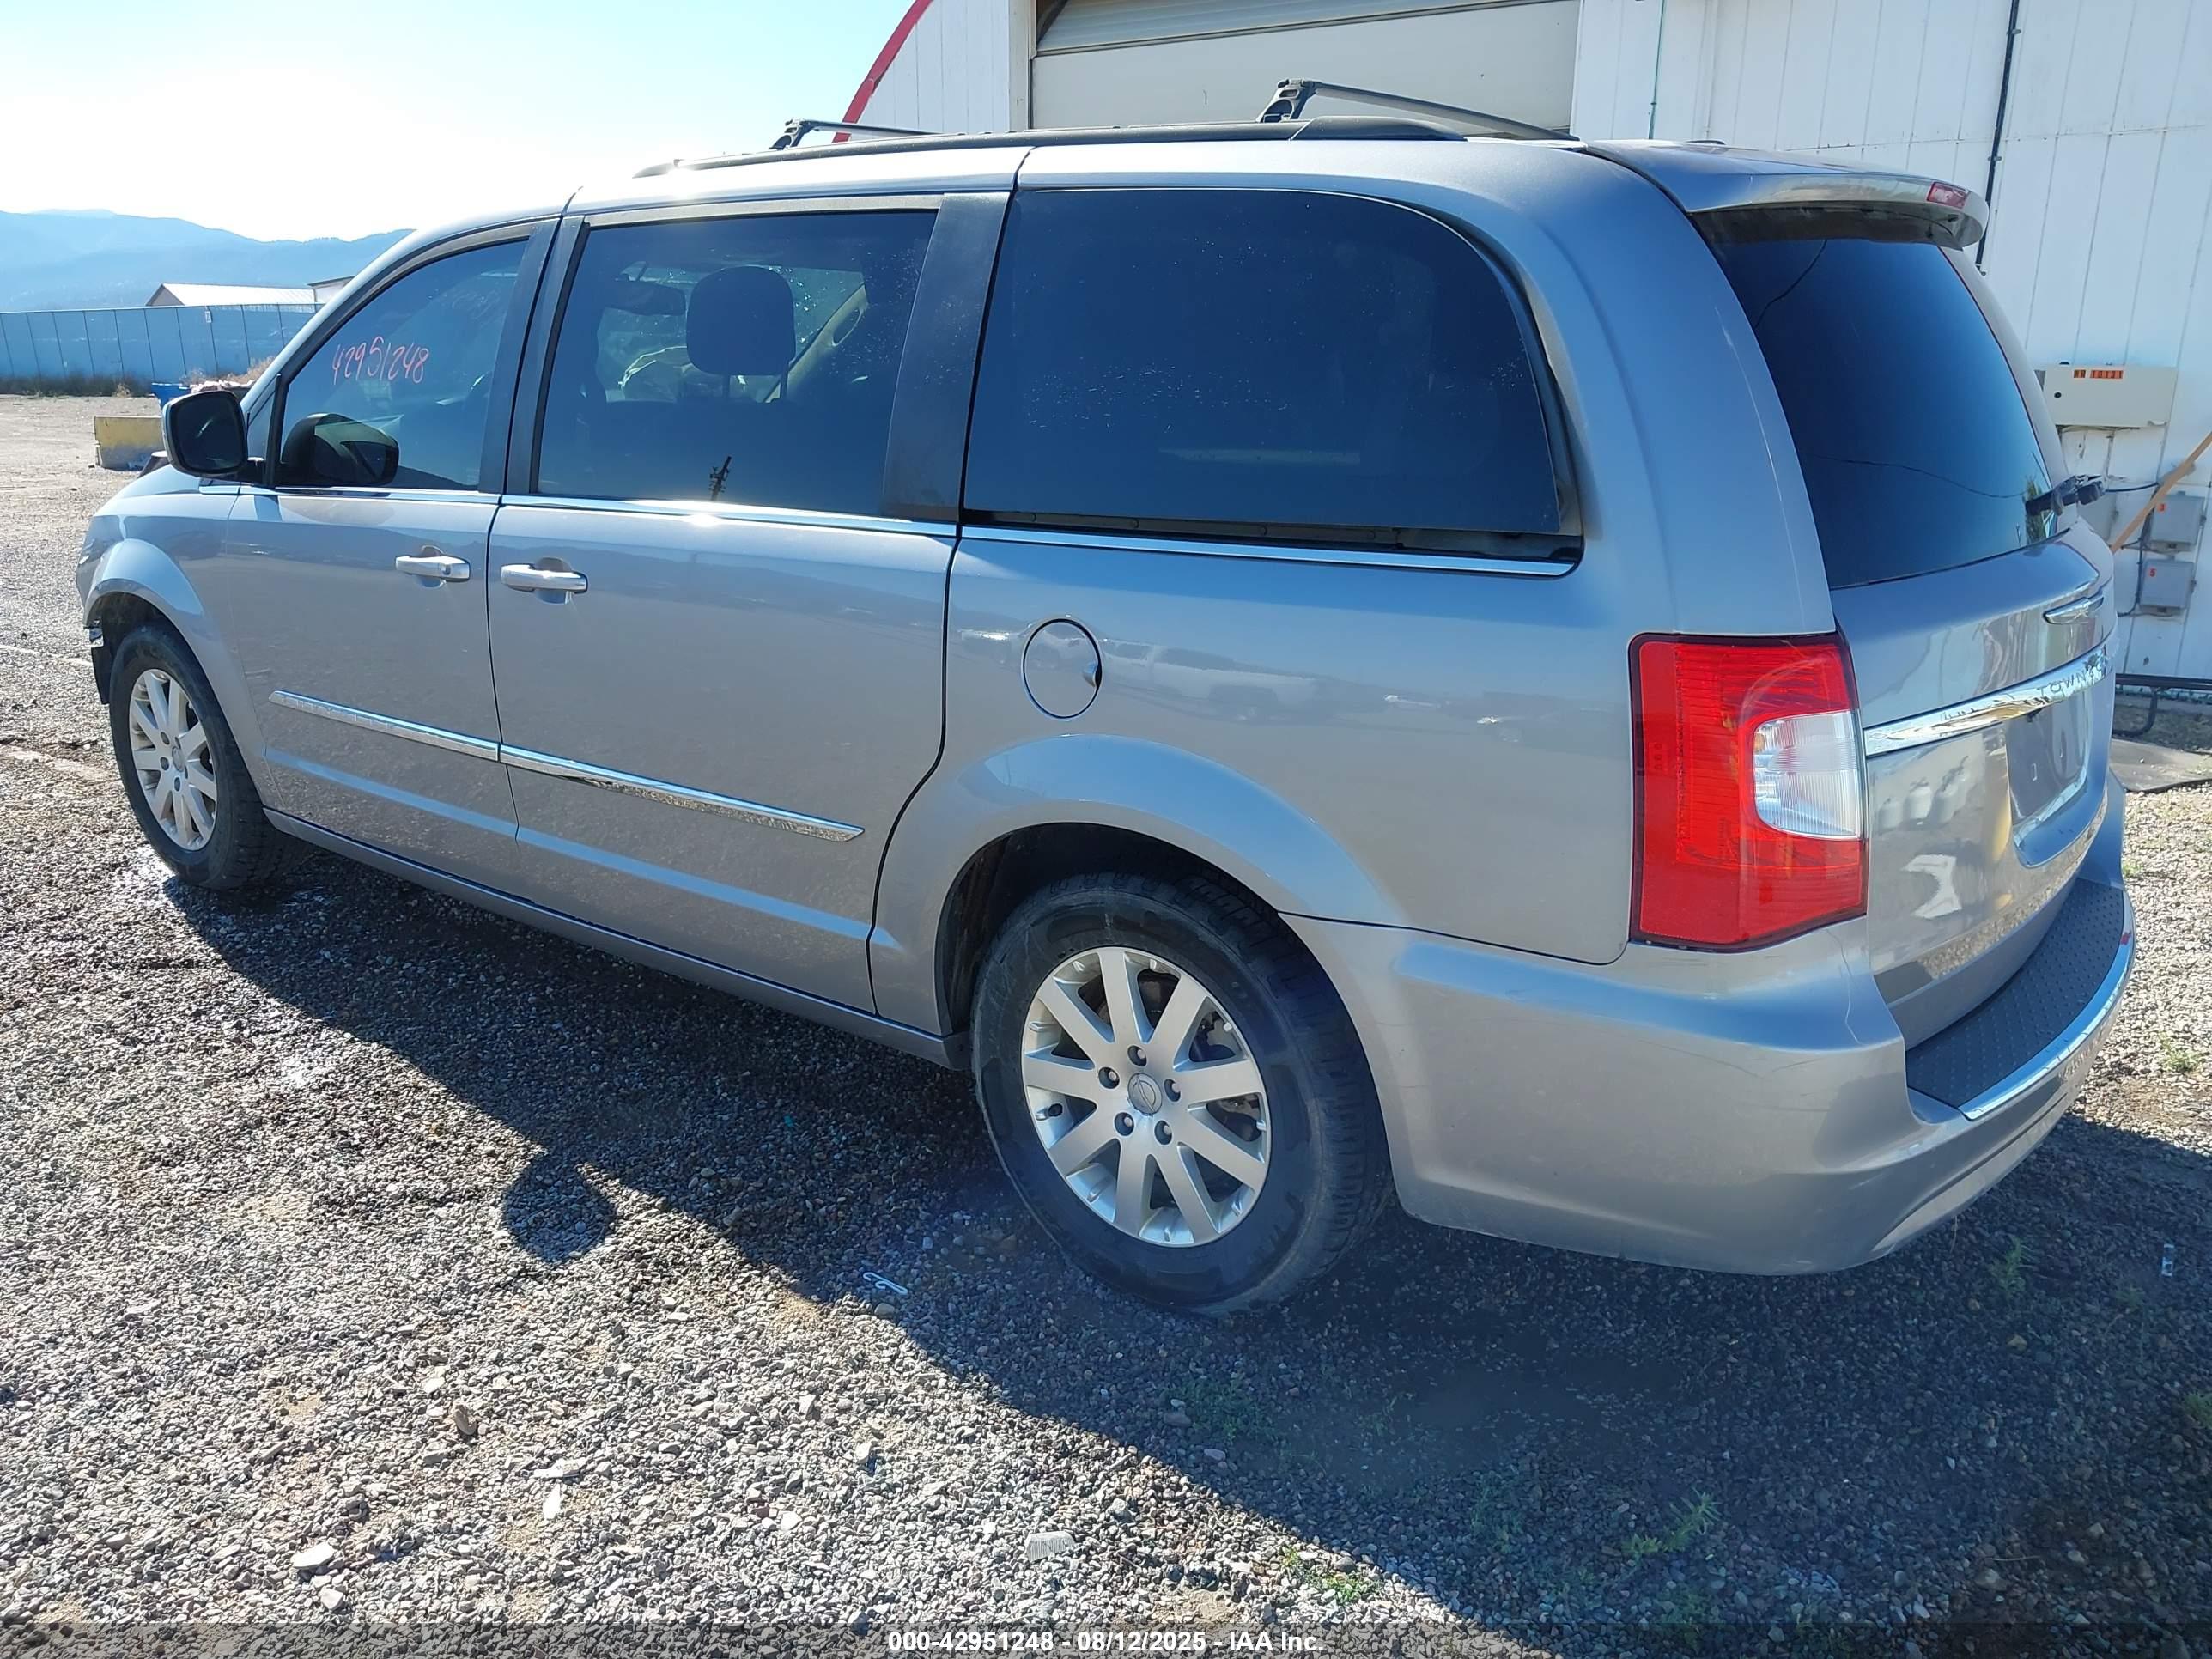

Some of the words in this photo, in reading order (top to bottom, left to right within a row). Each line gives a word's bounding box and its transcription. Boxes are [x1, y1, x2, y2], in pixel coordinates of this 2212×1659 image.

[331, 336, 429, 386] 42951248
[2148, 568, 2156, 577] 5
[2036, 669, 2087, 697] TOWN
